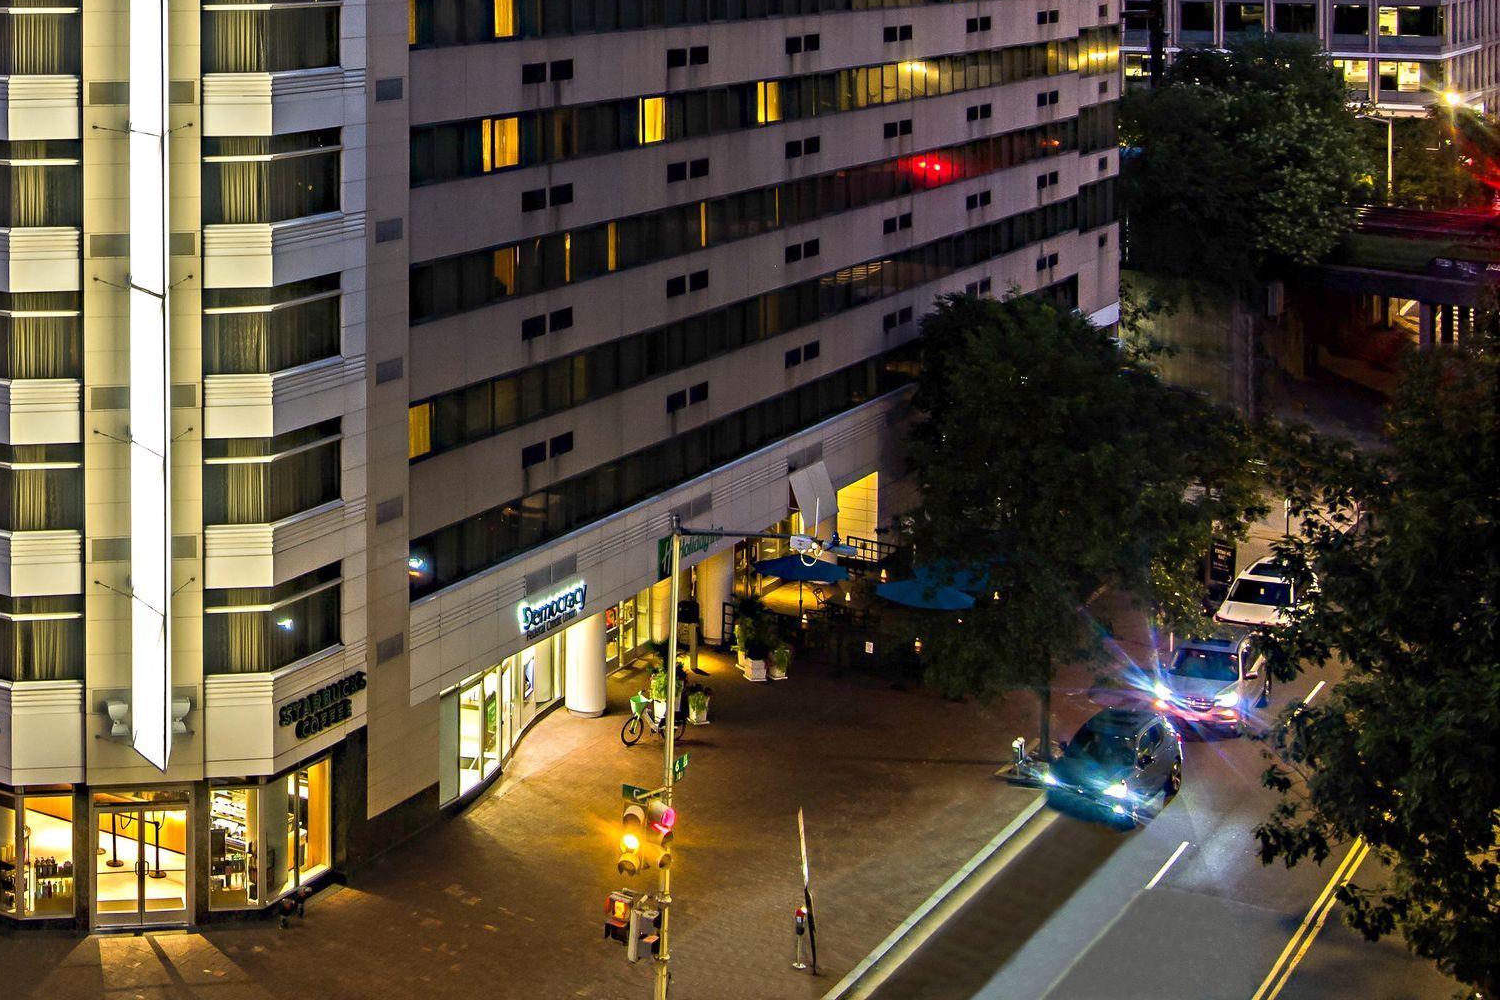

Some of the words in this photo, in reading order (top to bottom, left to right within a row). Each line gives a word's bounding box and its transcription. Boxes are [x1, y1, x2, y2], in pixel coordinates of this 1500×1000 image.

[522, 584, 587, 631] Democracy
[526, 624, 546, 641] Federal
[279, 671, 366, 726] STARBUCKS
[295, 698, 352, 739] COFFEE
